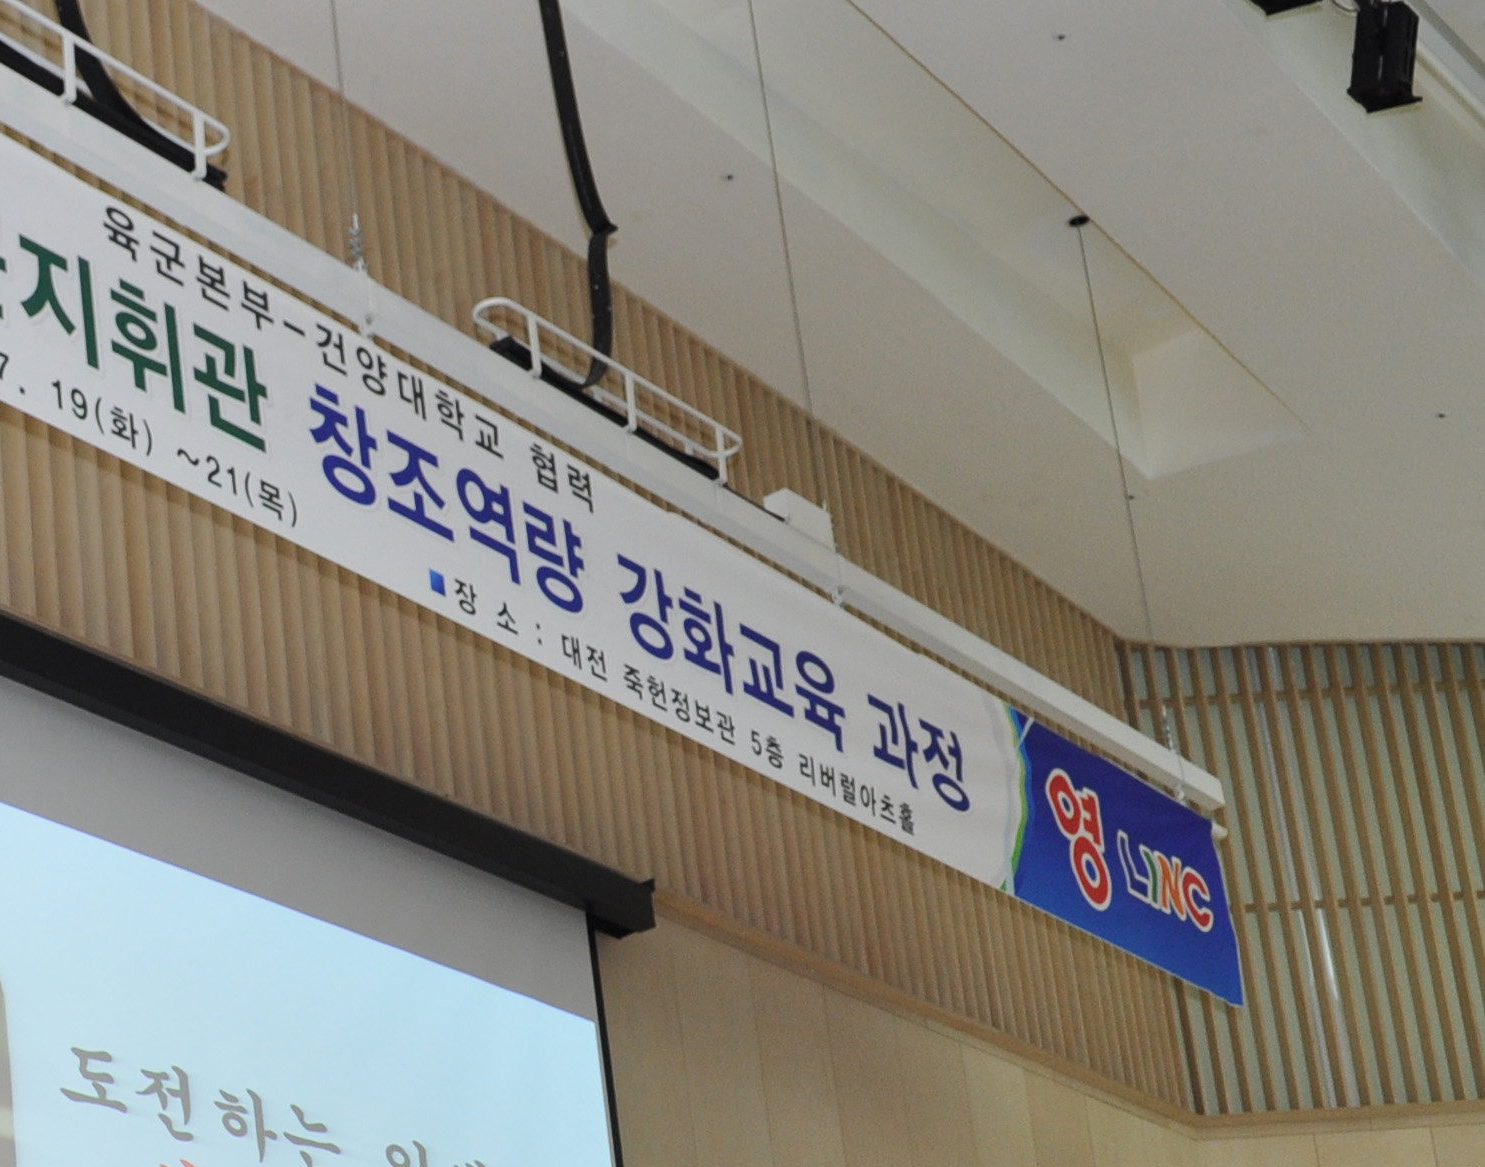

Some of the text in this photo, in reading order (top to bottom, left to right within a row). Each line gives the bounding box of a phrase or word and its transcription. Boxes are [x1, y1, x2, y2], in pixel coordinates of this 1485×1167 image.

[530, 443, 595, 513] 협력
[310, 384, 585, 614] 창조역량
[617, 553, 846, 752] 강화교육
[867, 693, 971, 813] 과정
[561, 633, 608, 683] 대전
[623, 663, 736, 746] 죽헌정보관
[750, 730, 784, 770] 5층
[799, 753, 914, 836] 리버럴아츠홀
[1045, 767, 1112, 911] 영
[1117, 830, 1214, 932] LINC
